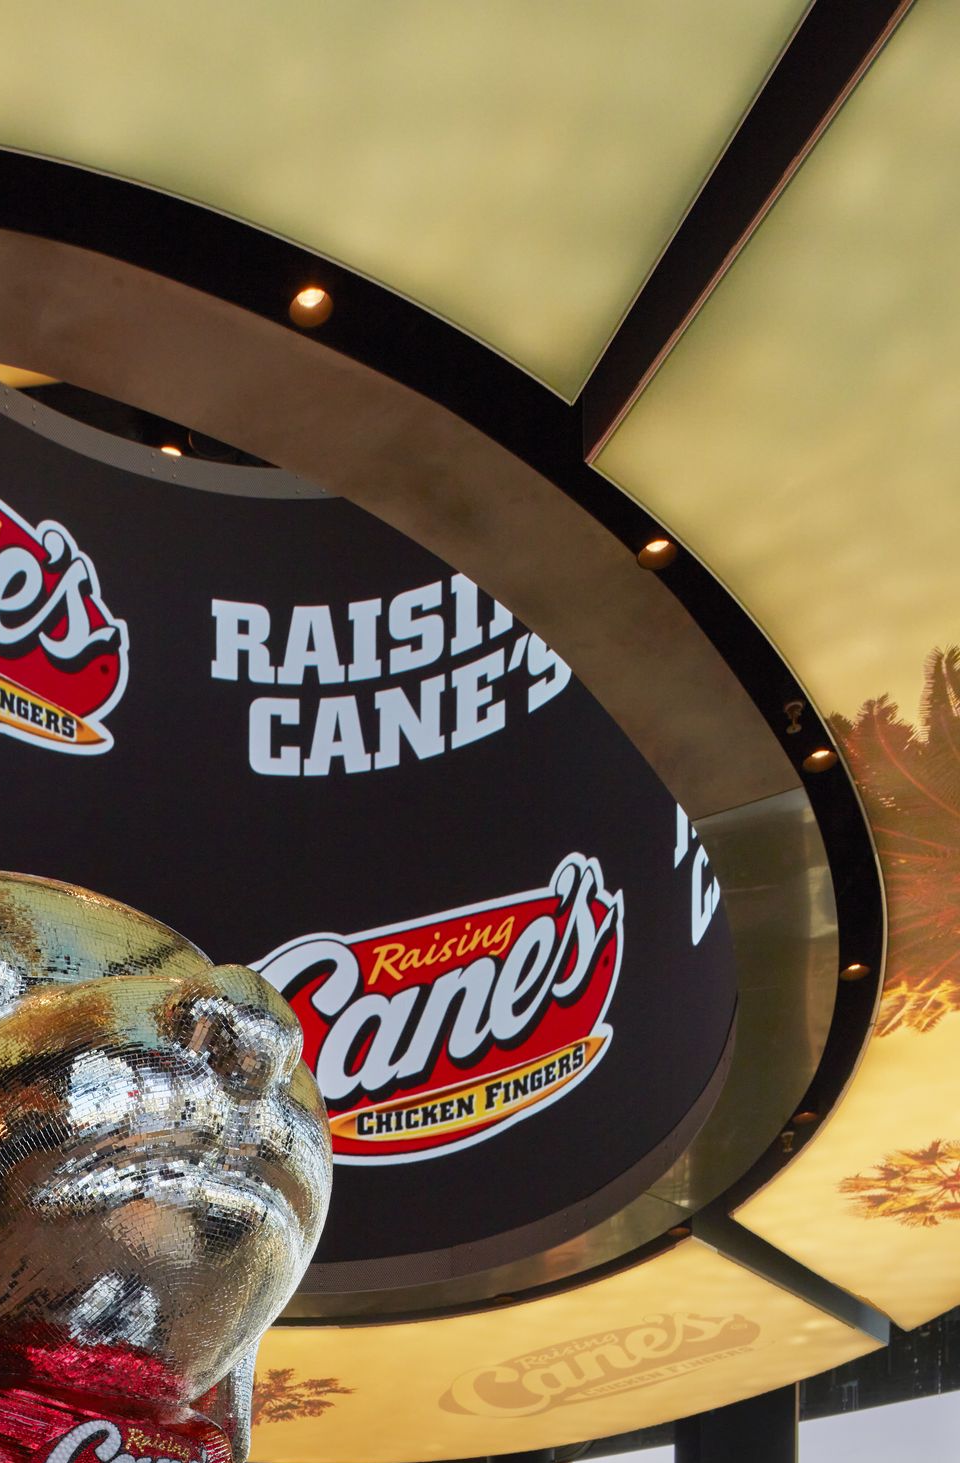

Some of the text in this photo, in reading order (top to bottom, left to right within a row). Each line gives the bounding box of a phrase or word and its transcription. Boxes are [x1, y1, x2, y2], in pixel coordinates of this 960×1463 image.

[248, 632, 573, 777] CANE'S
[368, 915, 516, 986] Raising
[356, 1043, 586, 1137] CHICKEN FINGERS
[450, 1312, 737, 1418] Cane's
[514, 1332, 620, 1370] Raising
